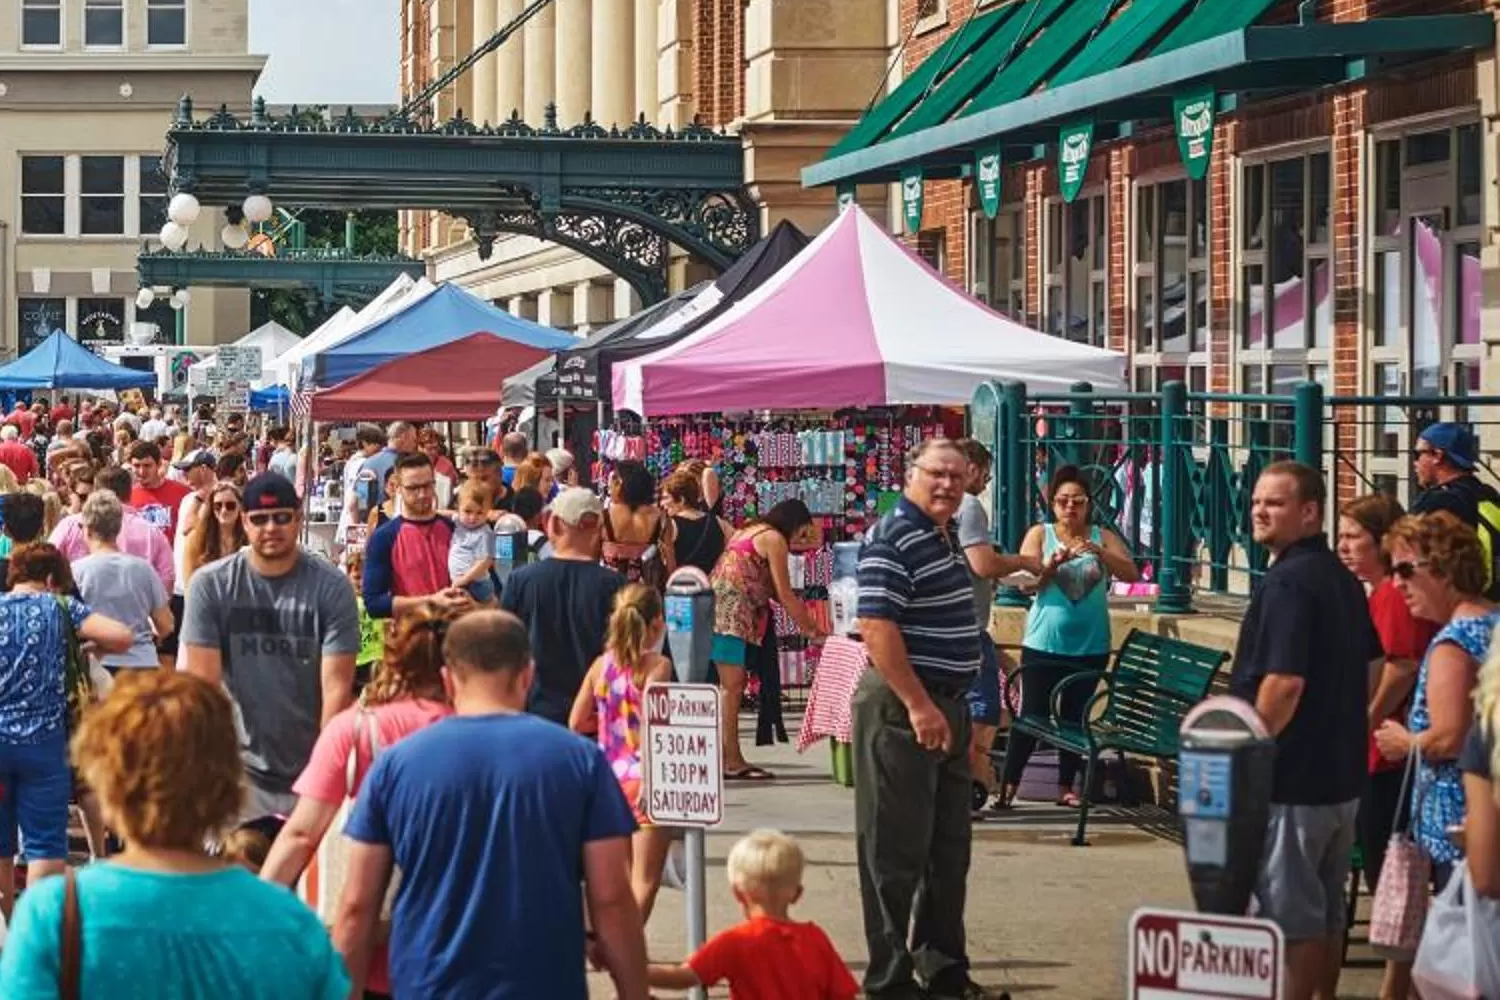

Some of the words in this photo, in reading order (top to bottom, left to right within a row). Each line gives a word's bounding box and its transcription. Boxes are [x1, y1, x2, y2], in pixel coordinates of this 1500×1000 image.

[649, 693, 669, 719] NO
[670, 698, 715, 718] PARKING
[654, 788, 717, 814] SATURDAY
[1137, 929, 1176, 978] NO
[1180, 940, 1270, 981] PARKING
